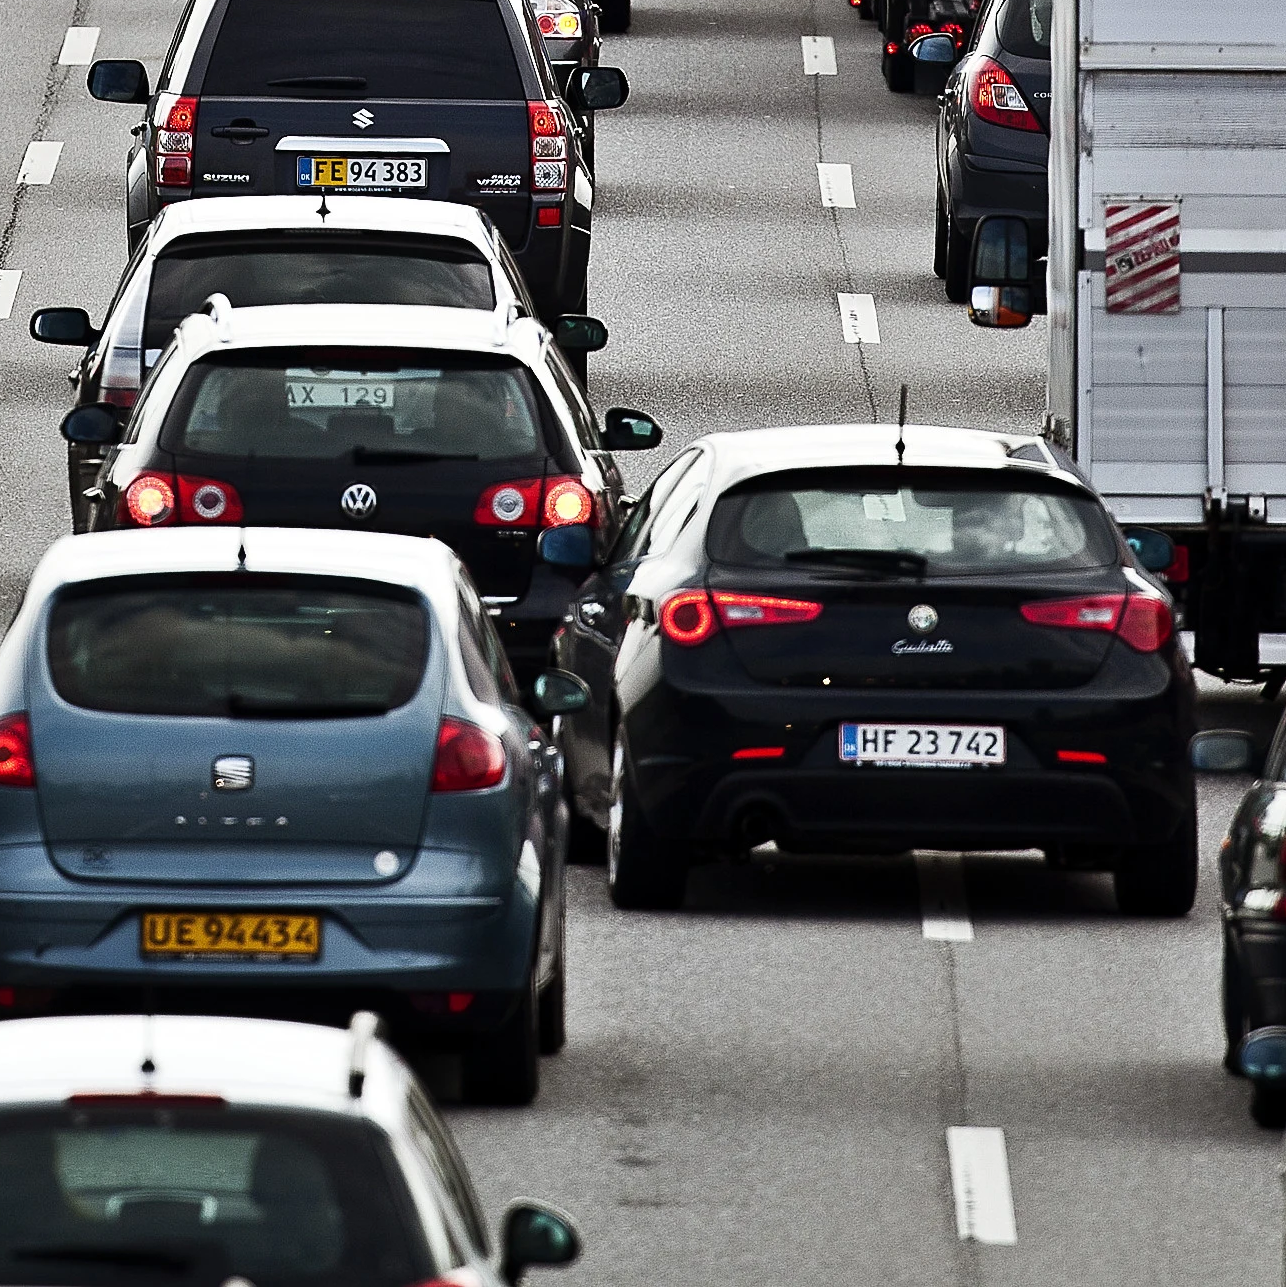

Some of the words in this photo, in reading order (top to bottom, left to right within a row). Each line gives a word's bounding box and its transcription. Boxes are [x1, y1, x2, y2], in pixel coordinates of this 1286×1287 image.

[203, 173, 250, 183] SUZUKI
[301, 173, 310, 181] DK
[315, 160, 344, 181] FE
[350, 162, 377, 182] 94
[382, 162, 422, 183] 383
[476, 178, 521, 187] VITARA
[339, 386, 388, 405] 129
[862, 729, 896, 753] HF
[907, 729, 939, 755] 23
[948, 730, 999, 757] 742
[147, 917, 196, 946] UE
